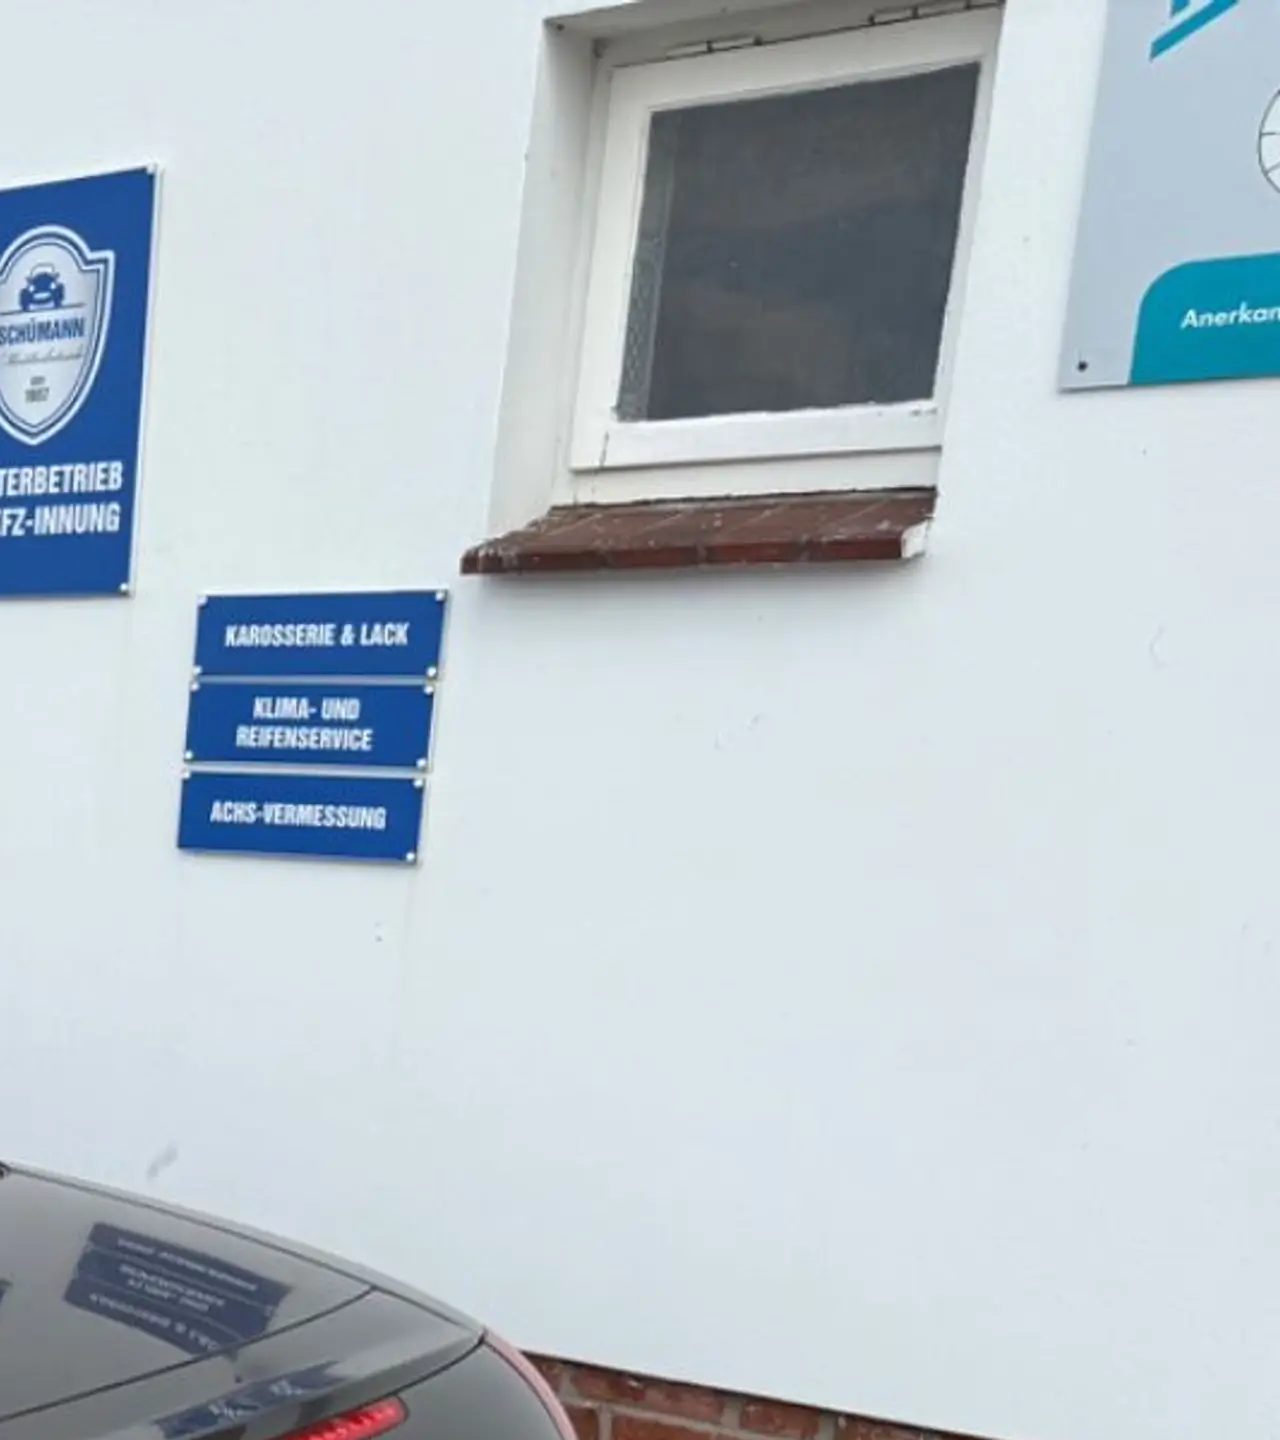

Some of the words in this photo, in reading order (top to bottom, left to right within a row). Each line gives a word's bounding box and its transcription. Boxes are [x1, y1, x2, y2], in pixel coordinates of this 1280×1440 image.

[225, 623, 336, 647] KAROSSERIE
[341, 623, 356, 646] &
[360, 621, 410, 646] LACK
[253, 696, 317, 720] KLIMA-
[321, 698, 361, 720] UND
[235, 724, 373, 751] REIFENSERVICE
[209, 801, 387, 830] ACHS-VERMESSUNG
